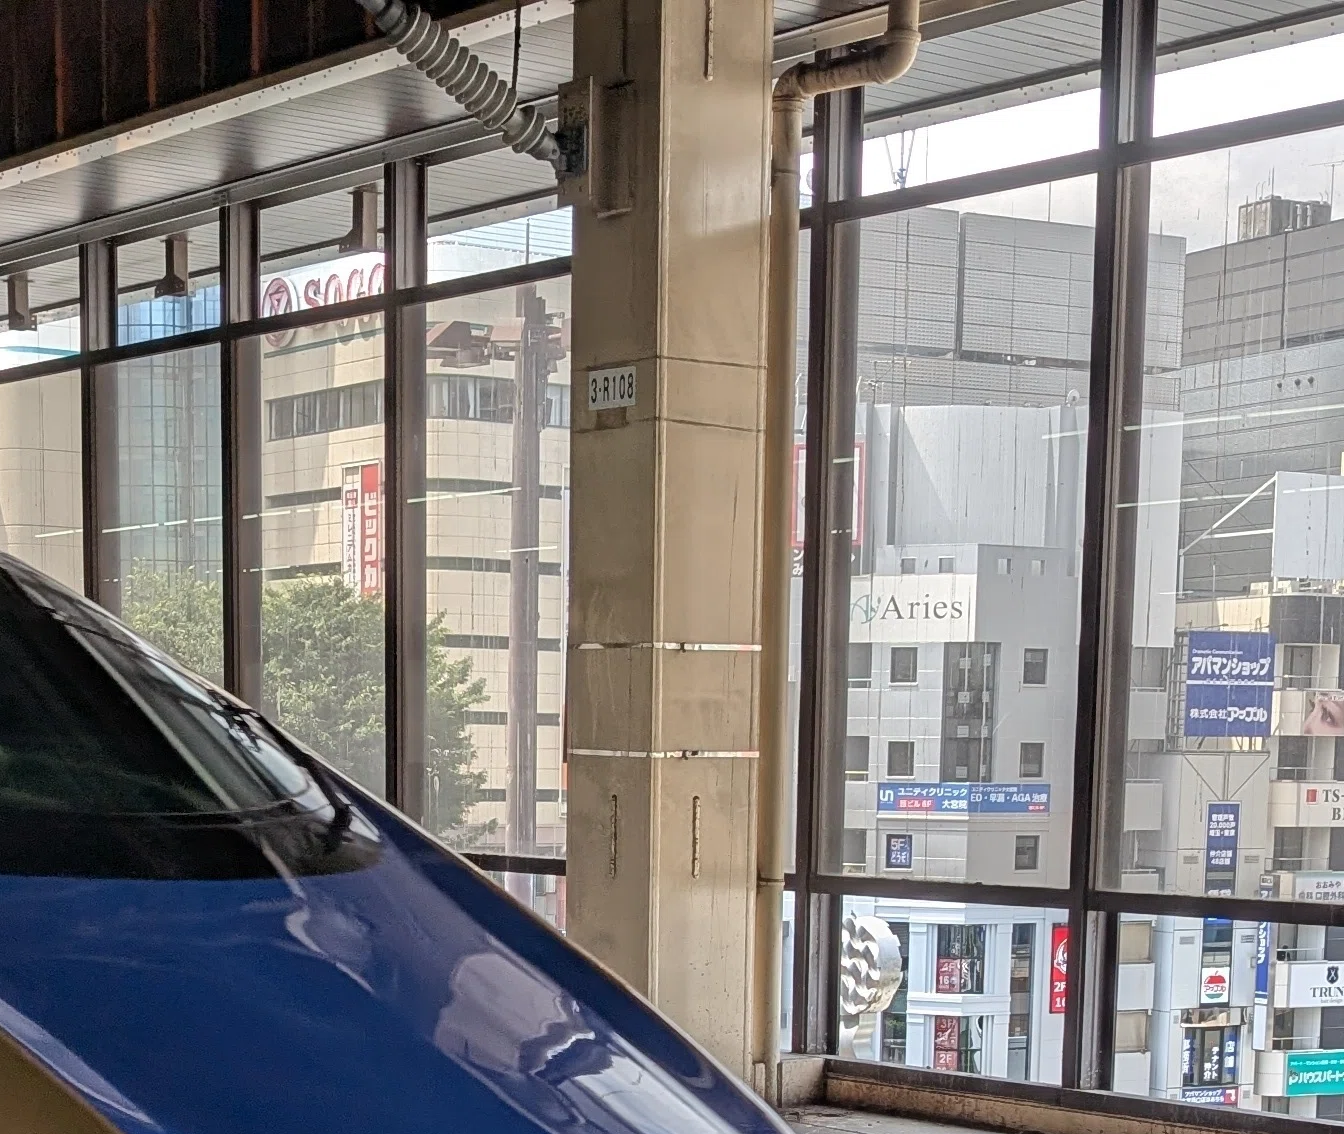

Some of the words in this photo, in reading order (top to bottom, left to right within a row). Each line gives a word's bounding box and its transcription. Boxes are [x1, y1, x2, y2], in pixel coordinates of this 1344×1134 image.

[880, 594, 963, 620] Aries
[1190, 655, 1272, 676] アパマンショップ
[1189, 706, 1268, 723] 株式会社アップル
[897, 787, 968, 797] ユニティクリニック
